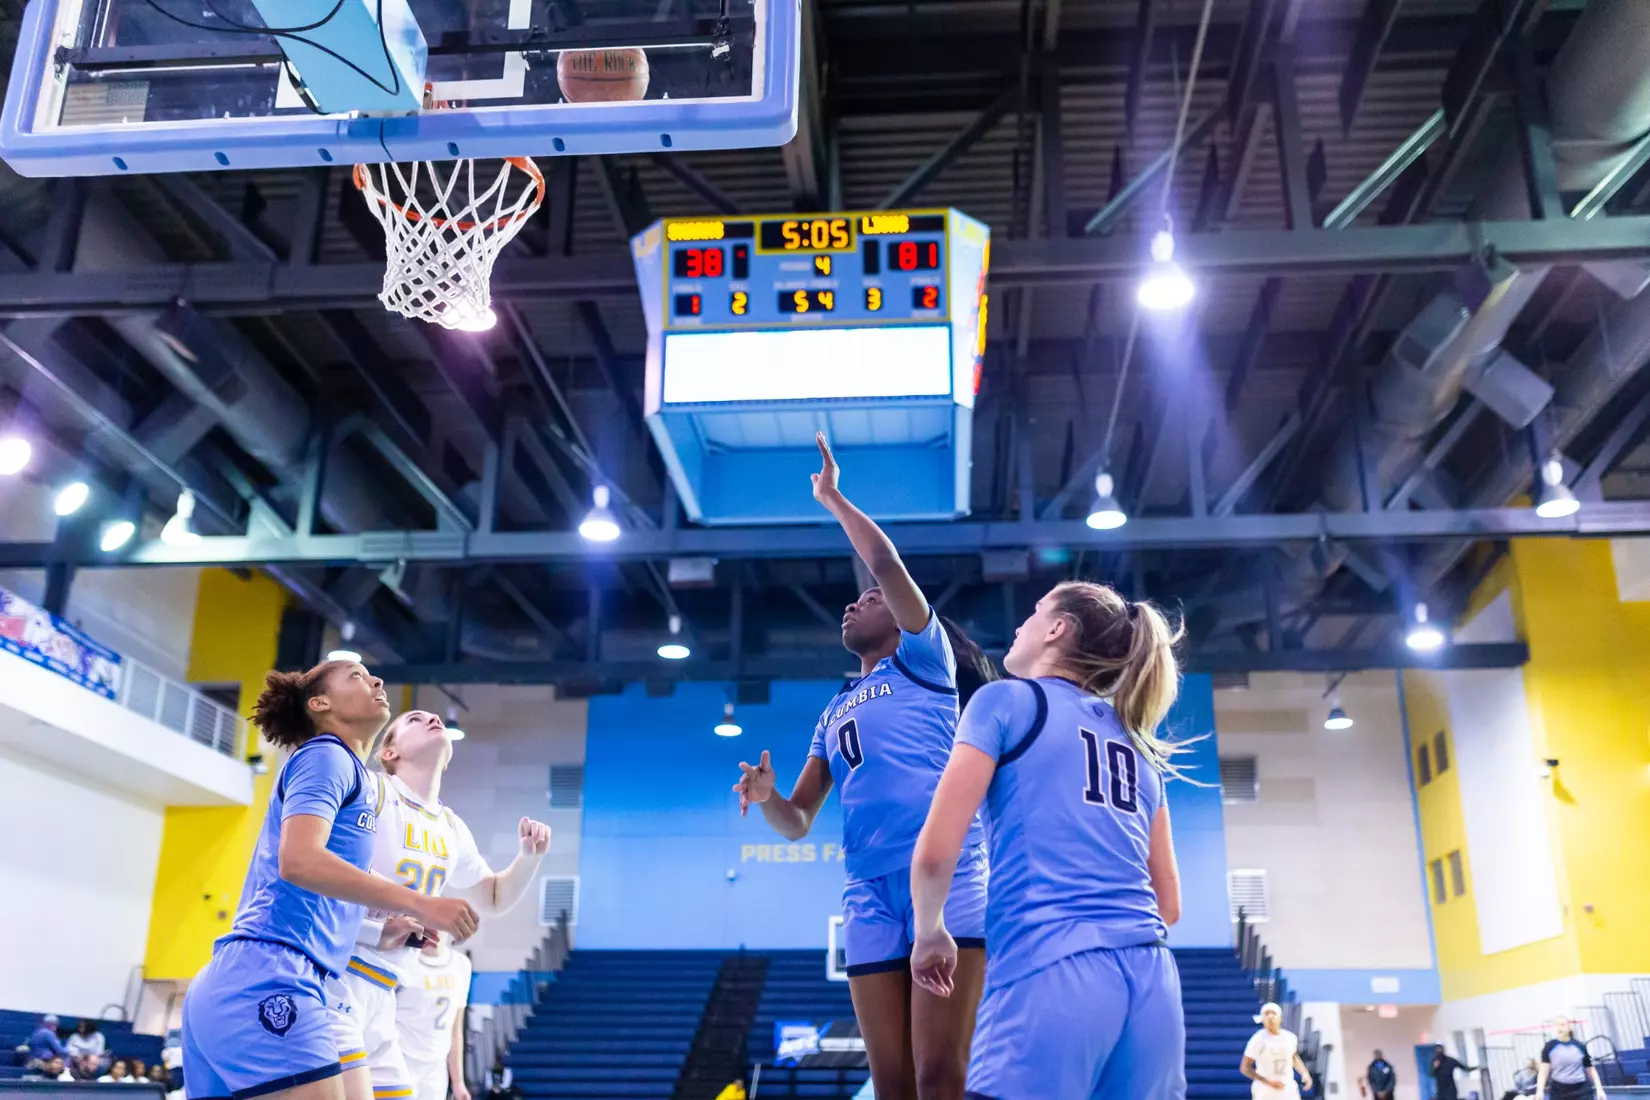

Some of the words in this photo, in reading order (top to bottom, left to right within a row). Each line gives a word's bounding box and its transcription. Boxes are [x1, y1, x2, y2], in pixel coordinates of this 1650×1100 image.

[782, 219, 849, 249] 5:05
[687, 248, 722, 278] 38
[815, 255, 831, 275] 4
[899, 241, 937, 271] 81
[691, 295, 700, 314] 1
[732, 291, 747, 315] 2
[868, 287, 881, 311] 3
[923, 285, 938, 309] 2
[838, 717, 865, 772] 0
[1079, 725, 1138, 816] 10
[404, 823, 449, 860] LIU
[742, 844, 816, 863] PRESS
[434, 996, 450, 1030] 2
